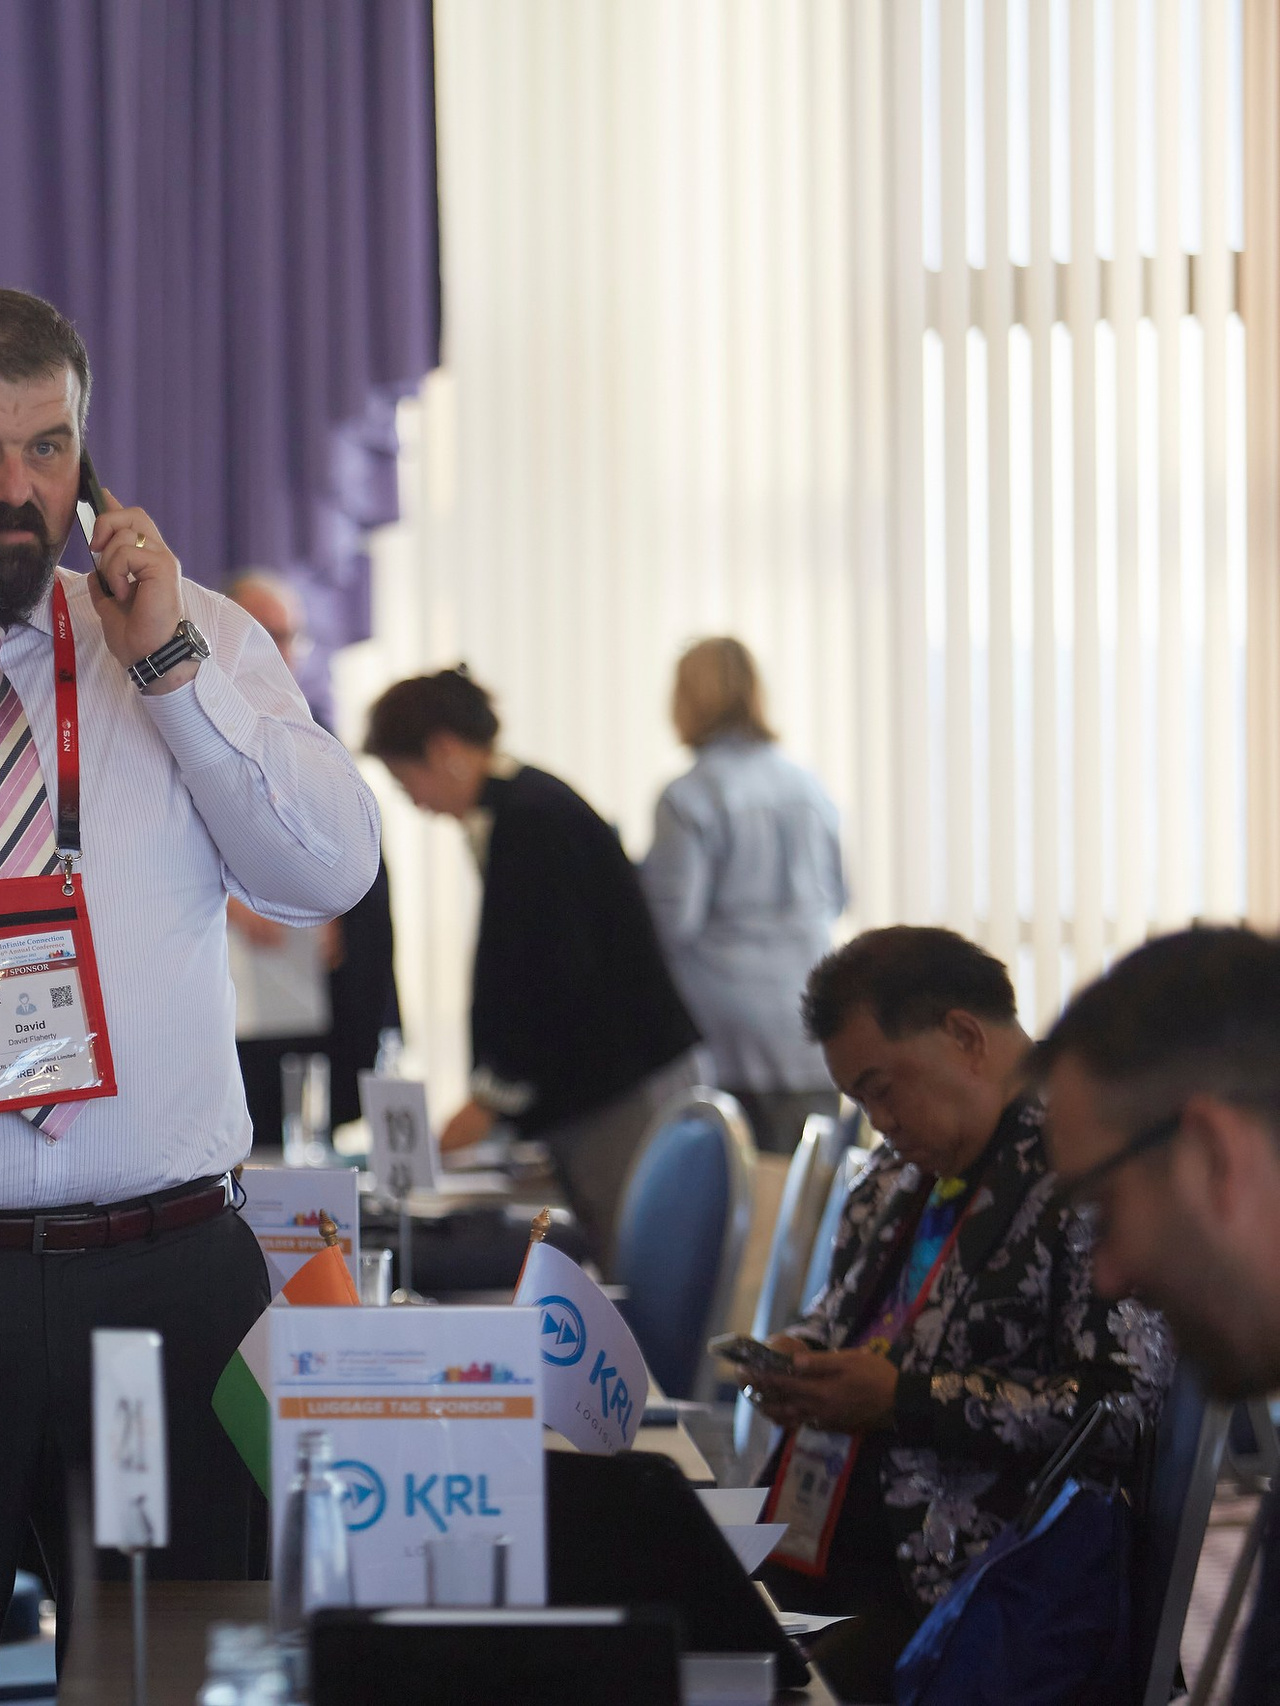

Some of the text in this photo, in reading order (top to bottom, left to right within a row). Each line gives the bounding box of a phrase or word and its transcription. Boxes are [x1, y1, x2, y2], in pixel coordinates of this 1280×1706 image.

[26, 935, 65, 945] Connection
[9, 946, 31, 955] Annual
[31, 943, 66, 951] Conference
[9, 963, 50, 976] SPONSOR
[14, 1020, 46, 1034] David
[8, 1033, 57, 1046] David Flaherty
[57, 1053, 77, 1061] Limited
[307, 1400, 505, 1415] LUGGAGE TAG SPONSOR
[404, 1472, 502, 1534] KRL
